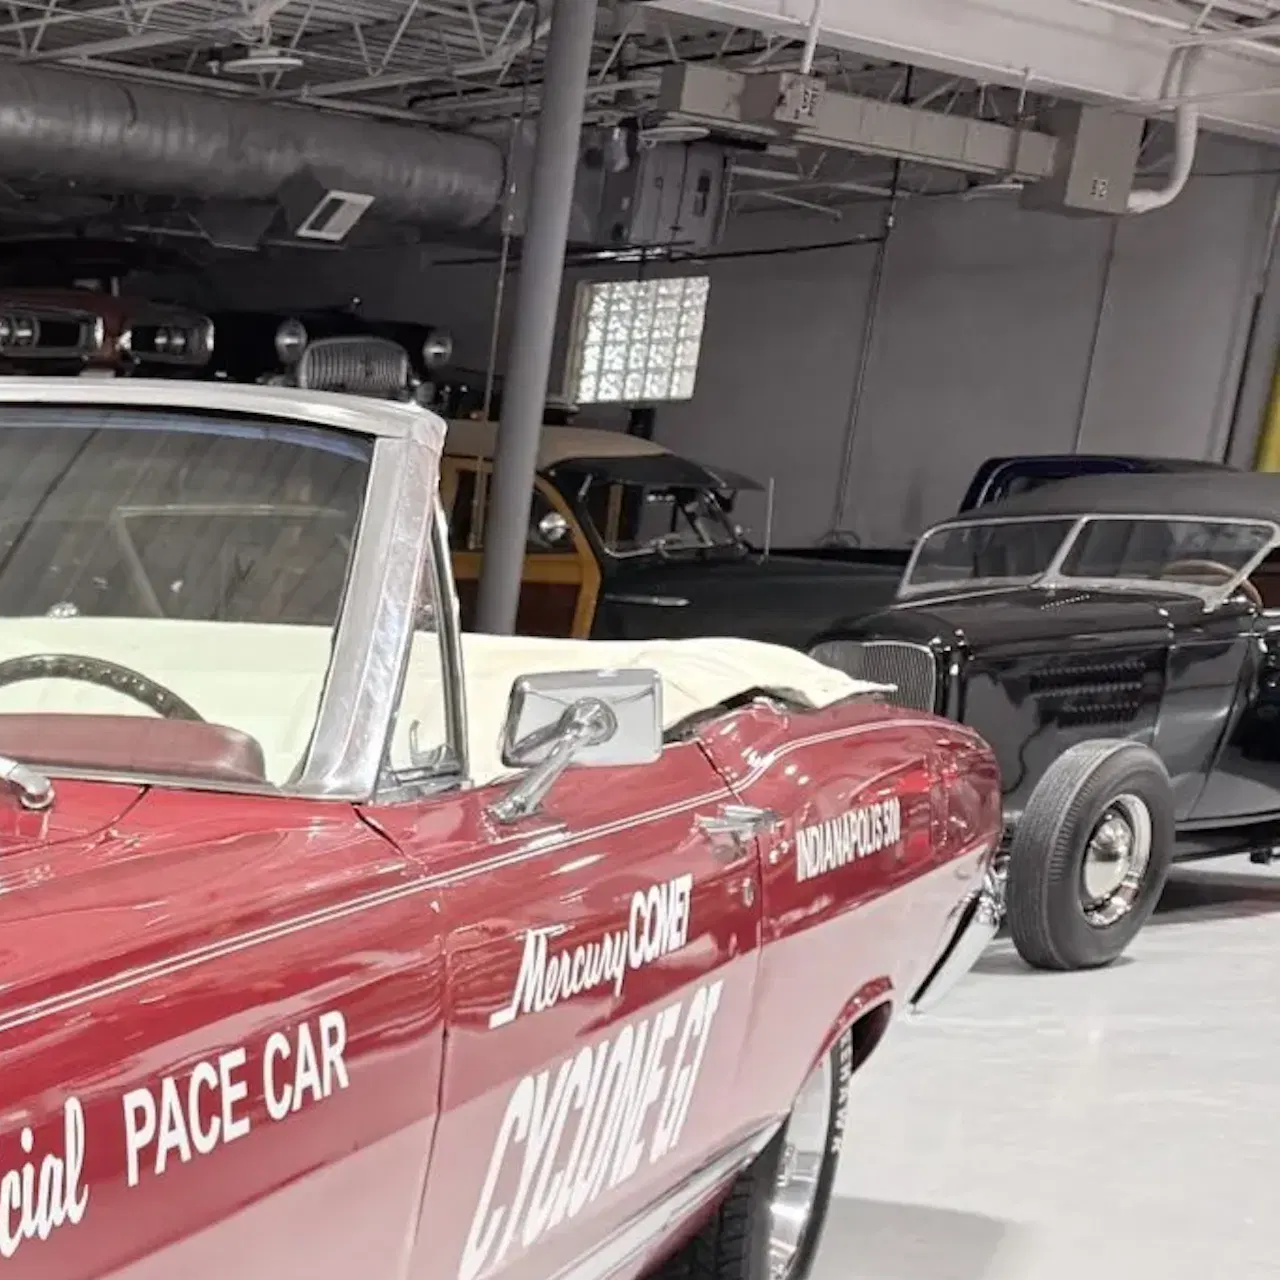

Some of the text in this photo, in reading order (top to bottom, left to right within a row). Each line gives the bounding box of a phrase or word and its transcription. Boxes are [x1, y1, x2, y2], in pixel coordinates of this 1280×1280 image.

[796, 802, 881, 883] INDIANAPOLIS
[489, 873, 692, 1029] Mercury COMET
[122, 1047, 250, 1187] PACE
[263, 1010, 349, 1120] CAR
[650, 979, 723, 1164] GT
